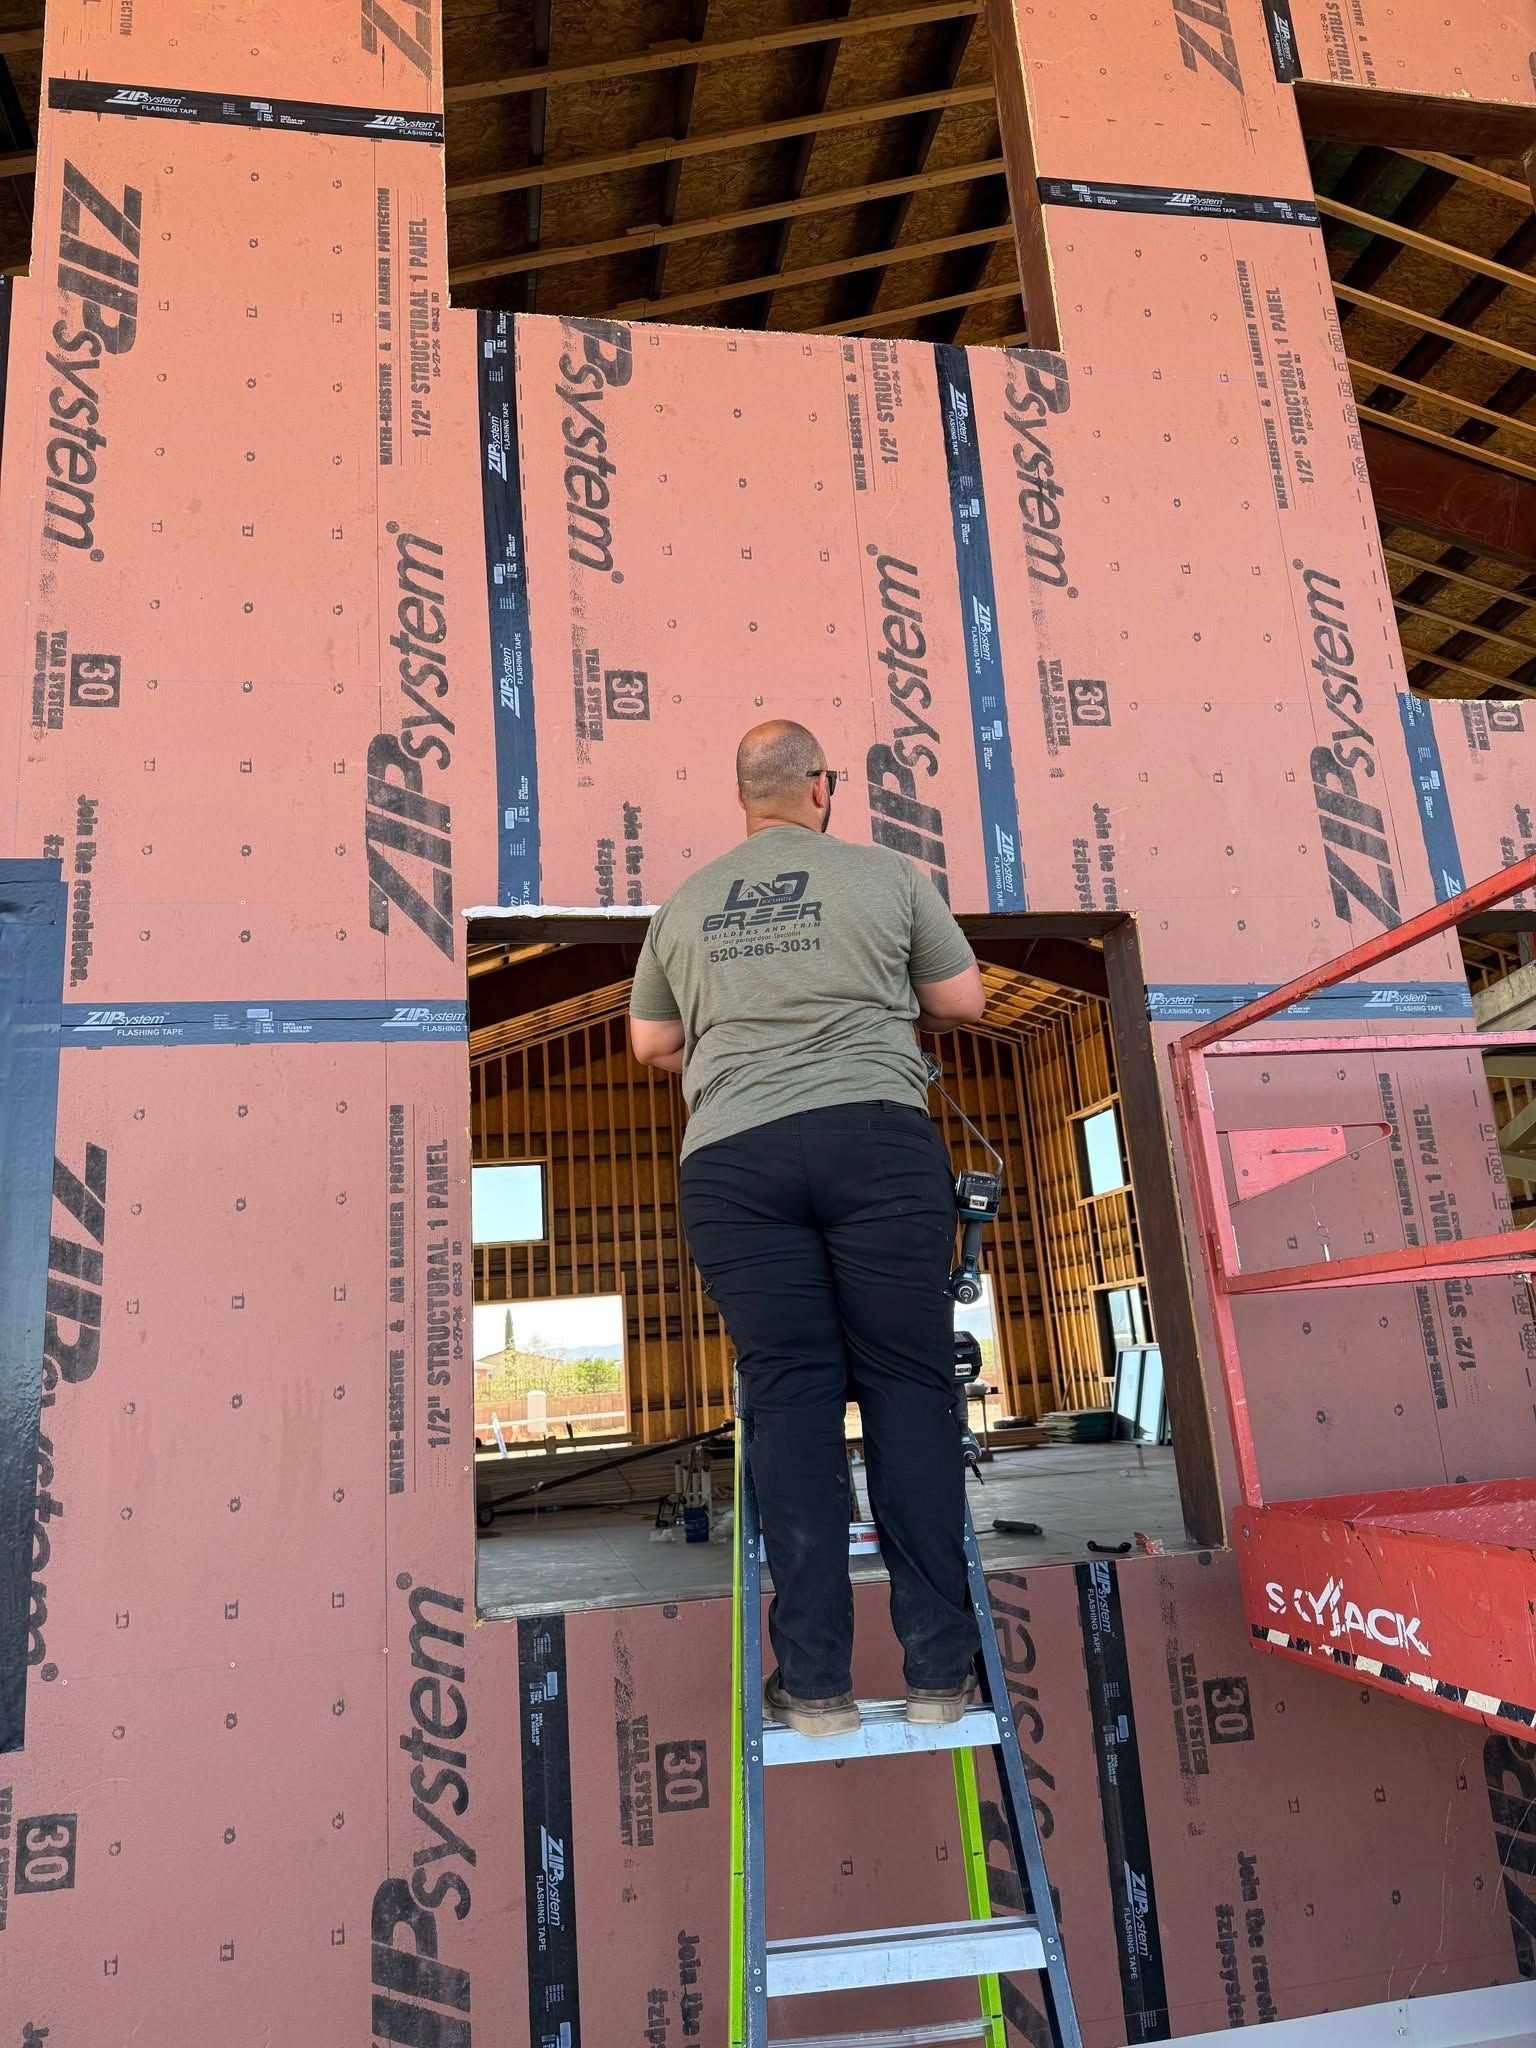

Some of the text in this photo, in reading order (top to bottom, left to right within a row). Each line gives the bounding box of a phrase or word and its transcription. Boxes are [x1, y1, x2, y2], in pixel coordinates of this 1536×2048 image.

[119, 0, 134, 36] ECTION
[1274, 33, 1282, 57] FLASHING
[1325, 2, 1354, 81] STRUCTURAL
[142, 105, 178, 113] FLASHING
[1193, 205, 1222, 213] FLASHING
[1236, 259, 1255, 319] PROTECTION
[1265, 287, 1287, 332] PANEL
[377, 187, 393, 466] WATER-RESISTIVE & AIR BARRIER PROTECTION
[408, 218, 432, 437] 1/2" STRUCTURAL 1 PANEL
[843, 344, 855, 363] AIR
[1247, 323, 1265, 367] BARRIER
[502, 402, 510, 418] TAPE
[871, 341, 899, 465] 1/2" STRUCTUR
[1256, 371, 1268, 389] AIR
[1277, 350, 1308, 445] STRUCTURAL
[1326, 308, 1369, 484] PARA APLICAR USE EL RODILLO
[555, 317, 633, 573] Psystem
[848, 393, 868, 491] WATER-RESISTIVE
[948, 411, 960, 456] FLASHING TAPE
[1264, 418, 1288, 510] WATER-RESISTIVE
[1294, 450, 1314, 484] 1/2"
[1003, 351, 1071, 588] Psystem
[47, 630, 68, 730] YEAR SYSTEM
[514, 632, 524, 685] FLASHING TAPE
[971, 626, 982, 675] FLASHING TAPE
[585, 648, 603, 742] YEAR SYSTEM
[1048, 659, 1071, 747] YEAR SYSTEM
[1471, 702, 1490, 751] SYSTEM
[623, 801, 644, 875] Join the
[1092, 803, 1117, 872] Join the
[1514, 803, 1533, 838] Join
[70, 794, 98, 987] Join the revolution.
[523, 880, 531, 898] TAPE
[595, 837, 617, 908] #zipsys
[993, 856, 1004, 907] FLASHING TAPE
[1072, 837, 1096, 911] #zipsyst
[702, 901, 822, 932] GREER
[703, 921, 821, 942] BUILDERS AND TRIM
[709, 937, 821, 963] 520-266-3031
[117, 1028, 183, 1037] FLASHING TAPE
[422, 1024, 461, 1033] FLASHING
[1145, 992, 1196, 1007] IPsystem
[1160, 1007, 1192, 1015] FLASHING
[1394, 1158, 1414, 1216] BARRIER
[1484, 1123, 1506, 1185] RODILLO
[1405, 1222, 1420, 1247] AIR
[1498, 1192, 1510, 1210] EL
[1413, 1104, 1477, 1371] 1/2" 1 PANEL
[389, 1104, 405, 1495] WATER-RESISTIVE & AIR BARRIER PROTECTION
[426, 1139, 451, 1449] 1/2" STRUCTURAL 1 PANEL
[1416, 1285, 1449, 1410] WATER-RESISTIVE
[1088, 1587, 1101, 1654] FLASHING TAPE
[1180, 1652, 1209, 1776] YEAR SYSTEM
[632, 1714, 655, 1848] YEAR SYSTEM
[370, 1585, 477, 2048] IPsystem
[536, 1874, 547, 1952] FLASHING TAPE
[1123, 1907, 1138, 1980] FLASHING TAPE
[1237, 1850, 1278, 2024] Join the revol
[677, 1929, 703, 2036] Join the
